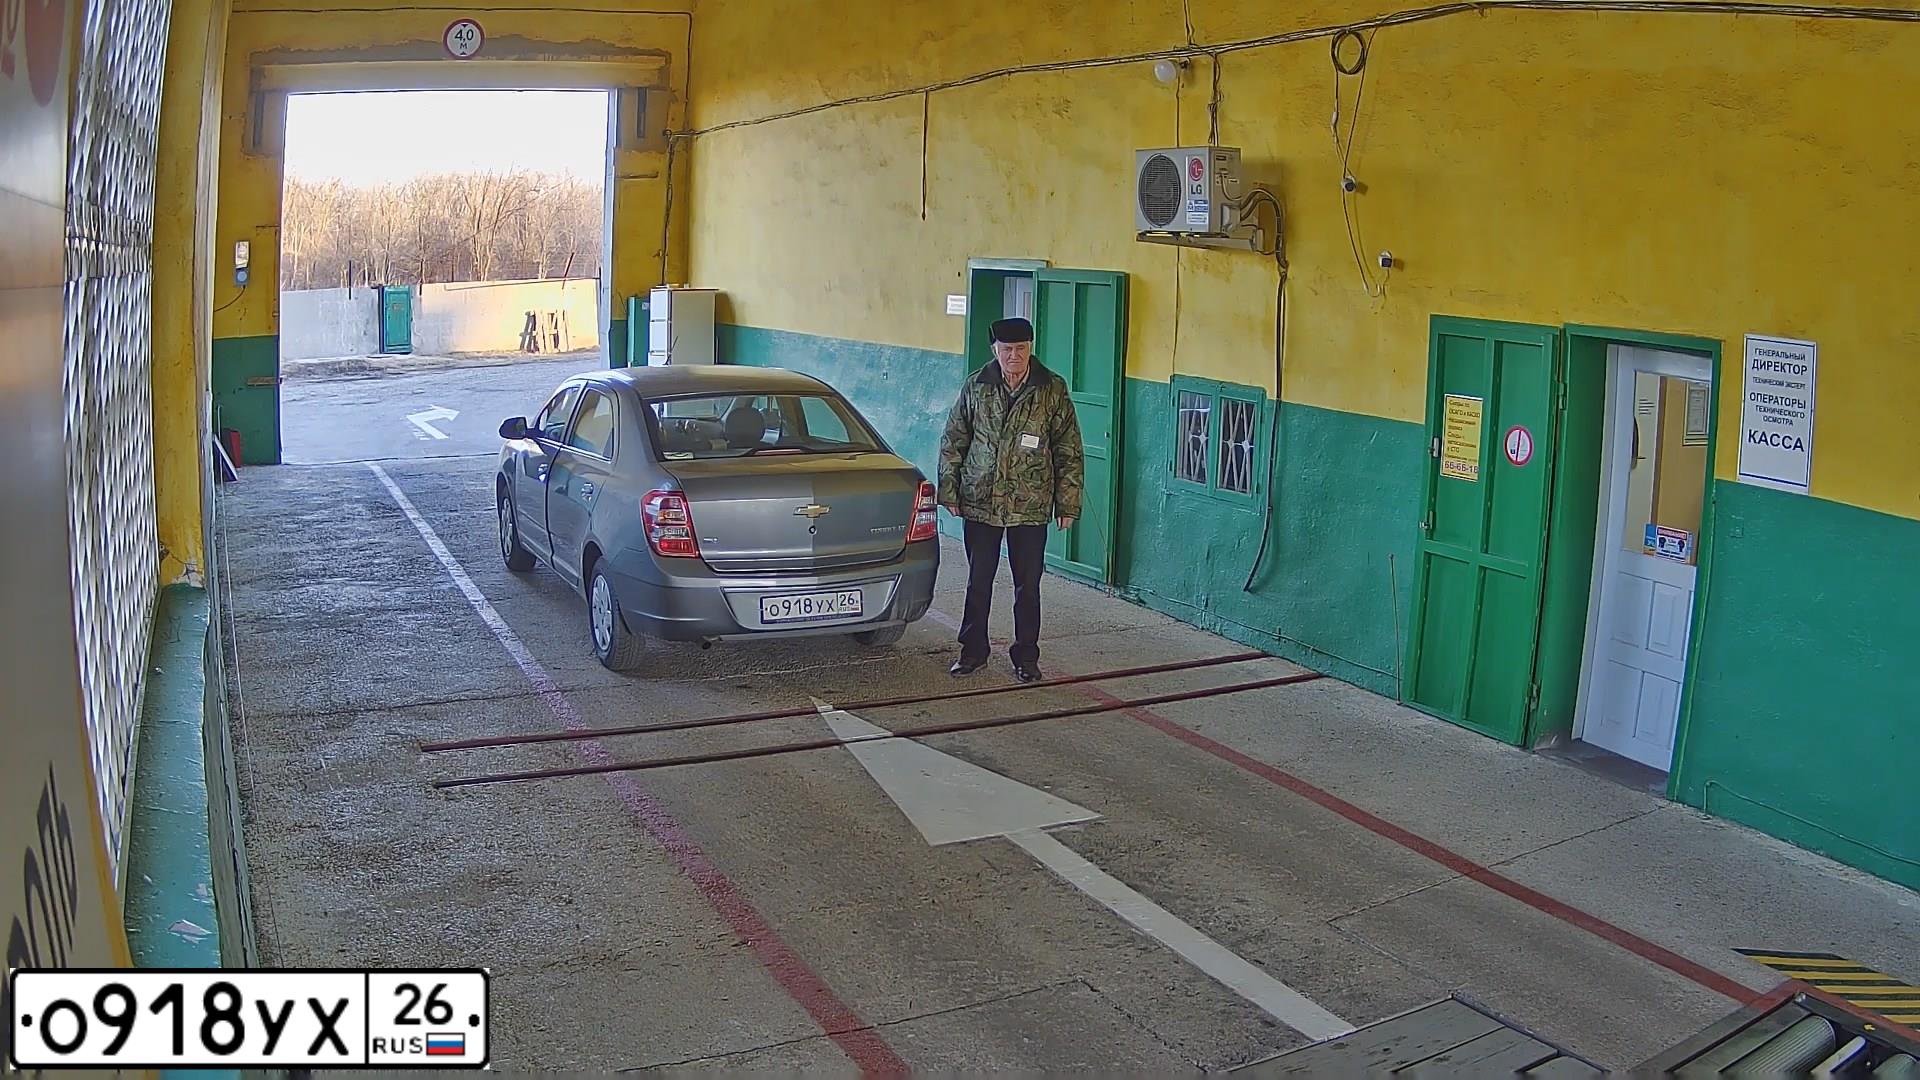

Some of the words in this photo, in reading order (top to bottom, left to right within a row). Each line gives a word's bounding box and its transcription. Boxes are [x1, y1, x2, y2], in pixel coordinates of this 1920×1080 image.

[455, 29, 474, 42] 4,0
[1190, 184, 1202, 195] LG
[1754, 347, 1806, 361] ГЕНЕРАЛЬНЫЙ
[1751, 359, 1808, 376] ДИРЕКТОР
[1749, 392, 1806, 410] ОПЕРАТОРЫ
[1755, 404, 1805, 420] ТЕХНИЧЕСКОГО
[1762, 415, 1794, 426] ОСМОТРА
[1748, 428, 1805, 452] КАССА
[838, 593, 855, 606] 26
